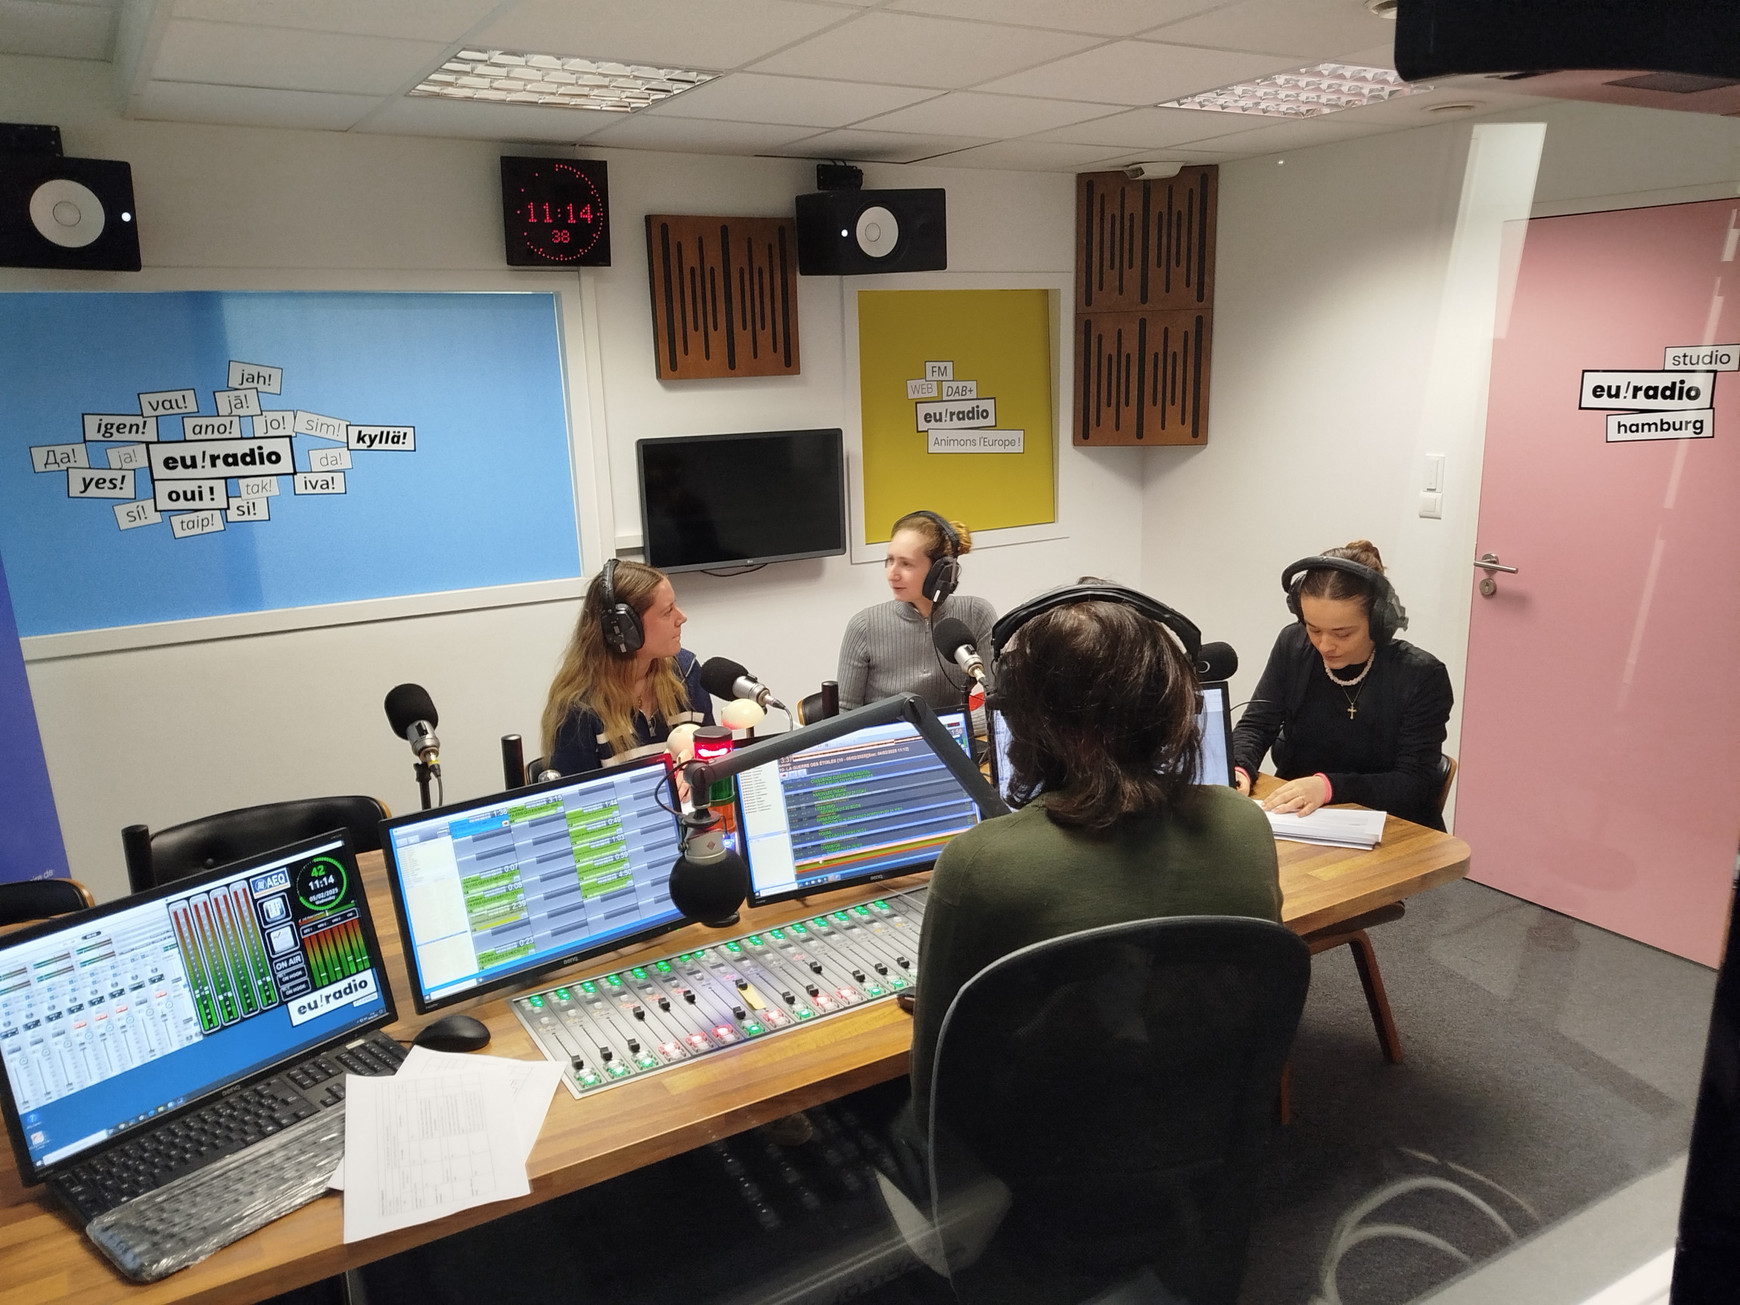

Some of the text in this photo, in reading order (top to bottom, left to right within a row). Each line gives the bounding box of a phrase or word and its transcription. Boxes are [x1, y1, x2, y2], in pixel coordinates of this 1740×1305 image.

[527, 202, 593, 224] 11:14
[551, 229, 570, 243] 38
[1671, 349, 1731, 366] studio
[238, 369, 272, 387] jah!
[931, 366, 948, 377] FM
[910, 383, 933, 395] WEB
[946, 385, 974, 397] DAB+
[1591, 379, 1701, 401] eu!radio
[227, 394, 250, 415] jā!
[923, 405, 990, 423] eu!radio
[96, 418, 148, 439] igen!
[191, 420, 234, 436] ano!
[263, 415, 286, 434] jo!
[304, 417, 341, 438] sim!
[1617, 418, 1705, 436] hamburg
[356, 429, 408, 448] kyllä!
[933, 437, 977, 447] Animons
[44, 448, 78, 470] Да!
[117, 449, 138, 470] ja!
[162, 445, 282, 471] eu!radio
[319, 453, 343, 467] da!
[79, 475, 127, 494] yes!
[245, 479, 273, 496] tak!
[303, 476, 336, 491] iva!
[236, 501, 257, 517] si!
[180, 513, 215, 532] taip!
[311, 865, 326, 877] 42
[267, 874, 286, 889] AEQ
[308, 874, 335, 891] 11:14
[275, 955, 302, 970] ON AIR
[297, 979, 368, 1015] eu!radio
